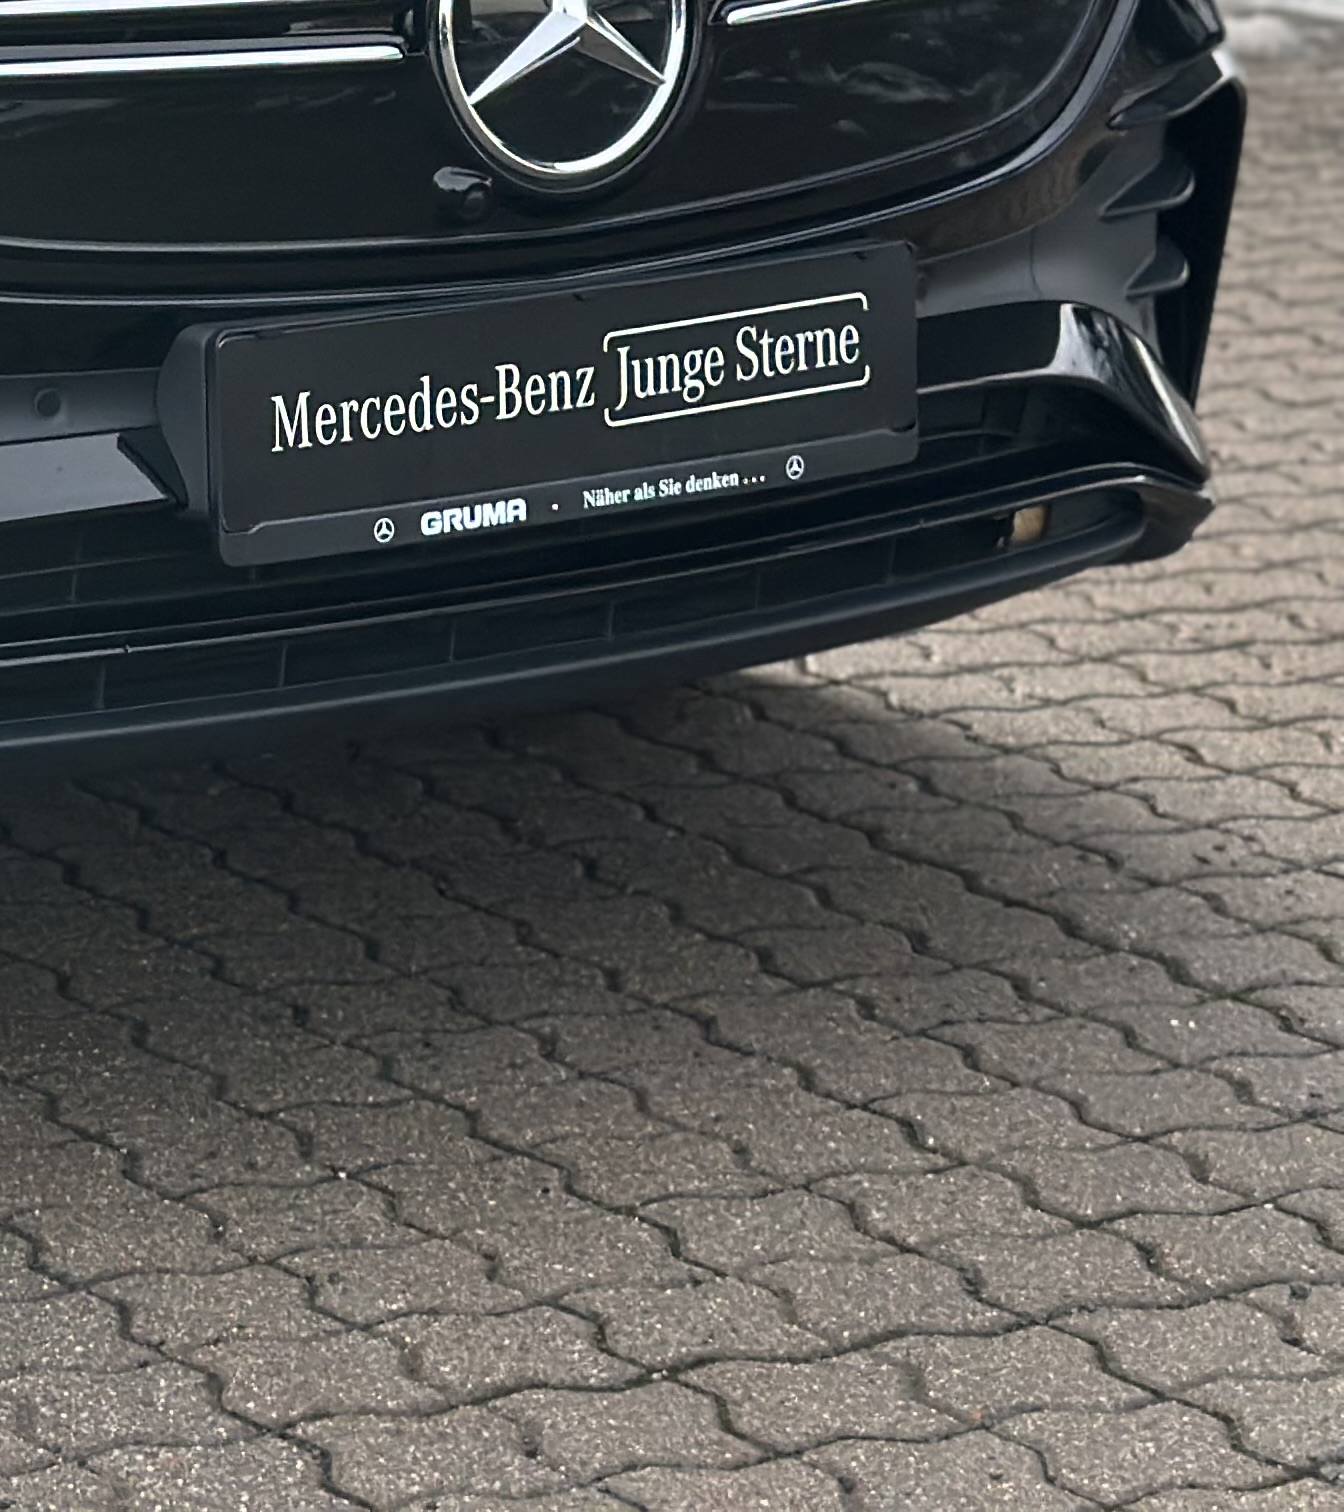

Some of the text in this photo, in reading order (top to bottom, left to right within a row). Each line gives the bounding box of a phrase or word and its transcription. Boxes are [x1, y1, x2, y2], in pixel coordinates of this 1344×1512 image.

[270, 324, 861, 453] Mercedes-Benz Junge Sterne
[582, 486, 632, 510] Näher
[633, 481, 656, 502] als
[658, 475, 683, 499] Sie
[420, 497, 528, 537] GRUMA
